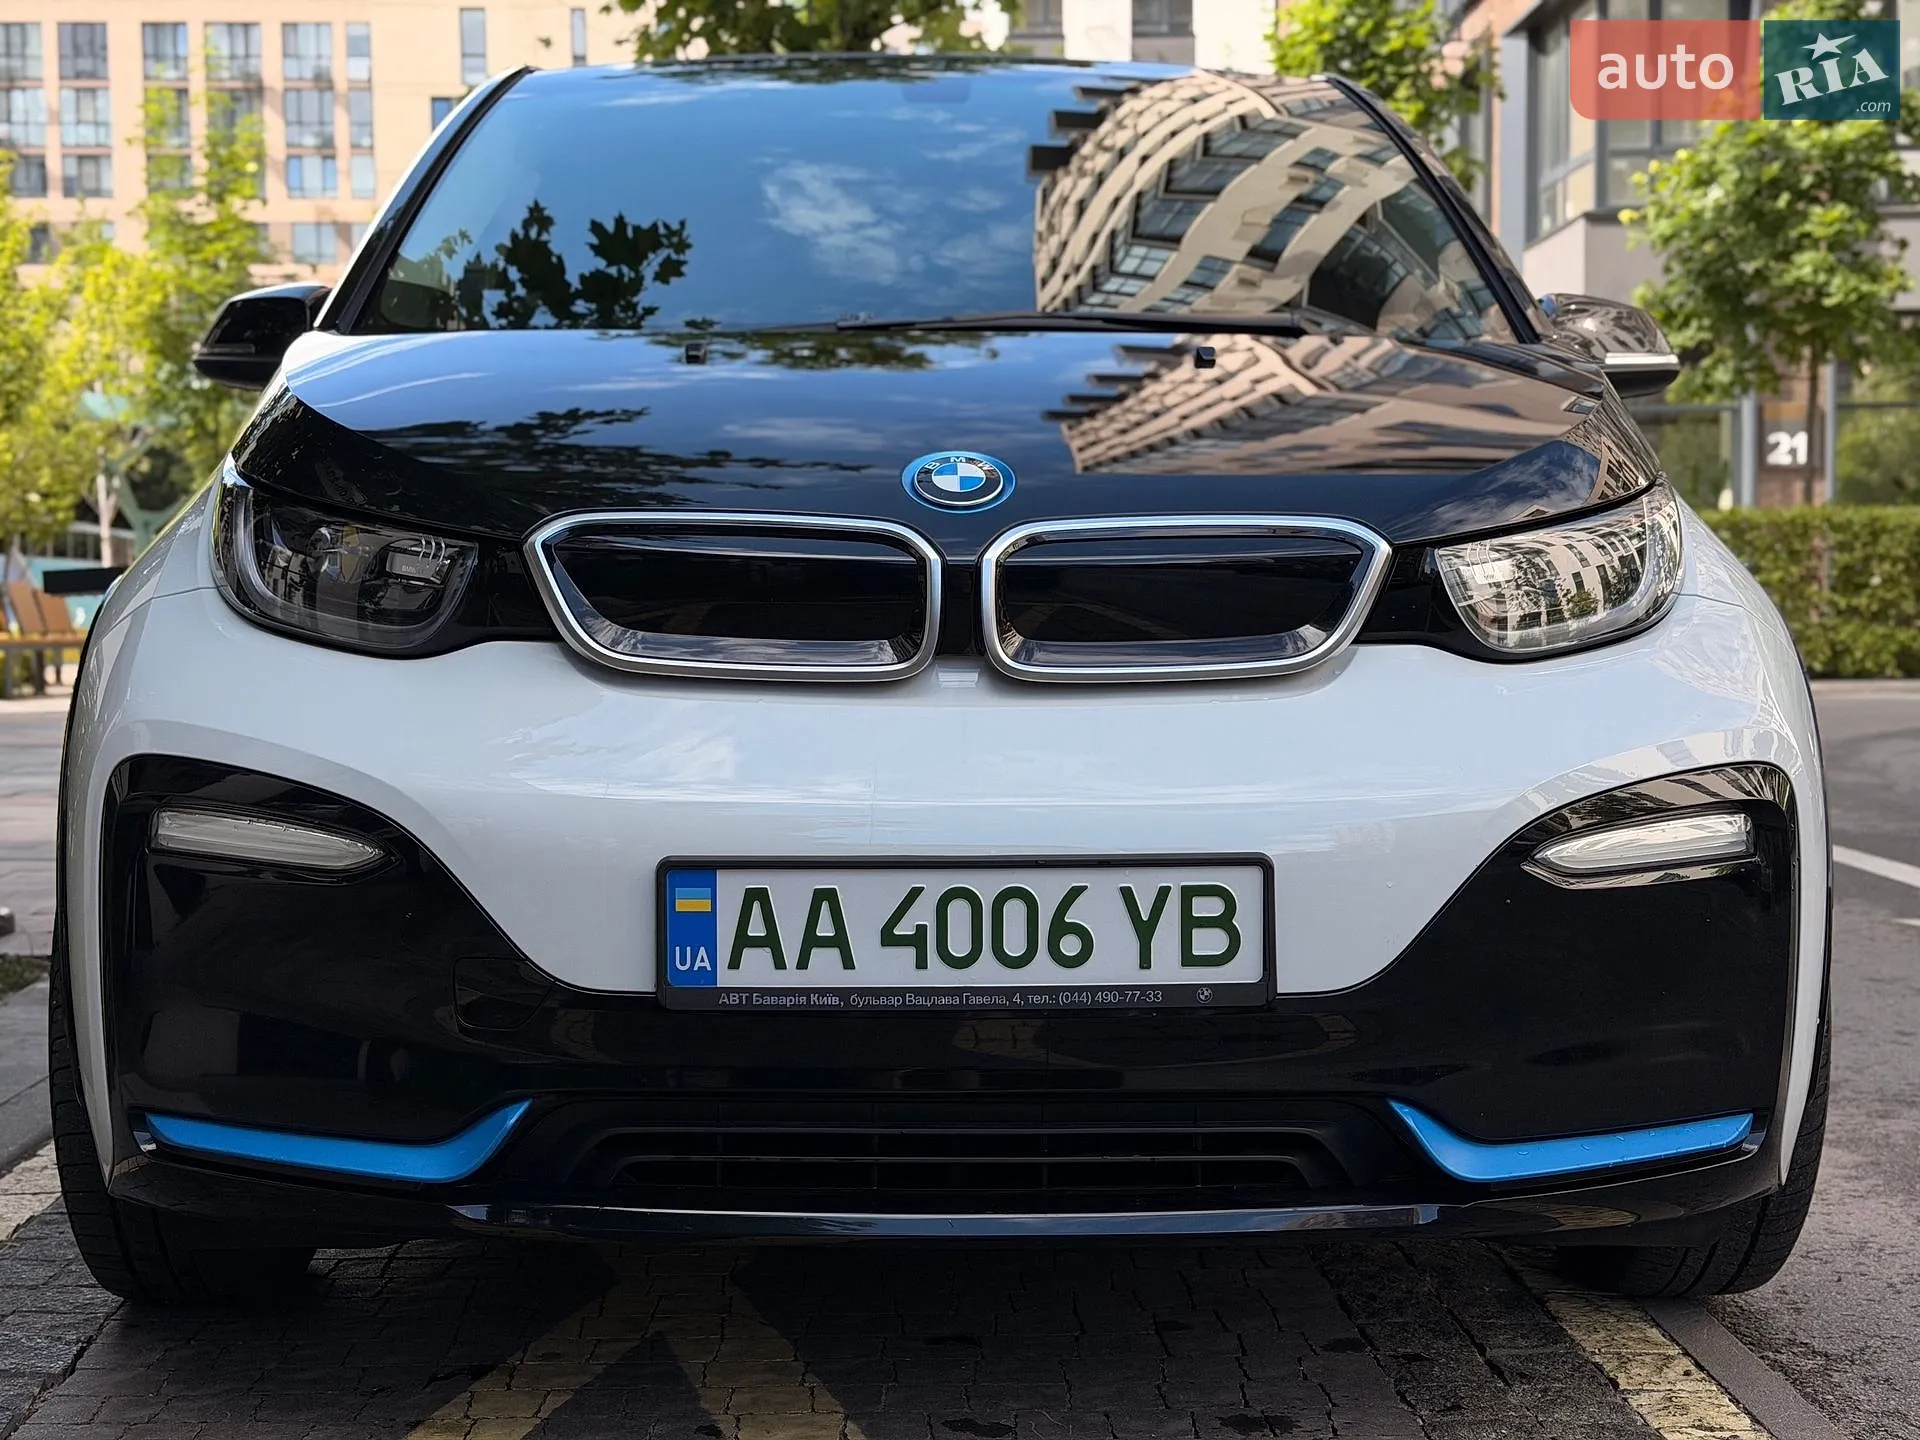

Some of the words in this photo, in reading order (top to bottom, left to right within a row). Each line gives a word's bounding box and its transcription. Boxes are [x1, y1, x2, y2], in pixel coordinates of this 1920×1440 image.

[1766, 431, 1808, 466] 21
[924, 456, 995, 471] BMW
[727, 886, 856, 970] AA
[880, 885, 1095, 969] 4006
[1119, 883, 1242, 969] YB
[675, 946, 711, 972] UA
[718, 992, 749, 1005] АВТ
[752, 993, 807, 1007] Баварія
[810, 992, 844, 1007] Київ,
[850, 993, 903, 1008] бульвар
[906, 993, 960, 1007] Вацлава
[963, 992, 1009, 1007] Гавела,
[1012, 992, 1024, 1006] 4,
[1059, 991, 1092, 1005] (044)
[1094, 990, 1162, 1003] 490-77-33
